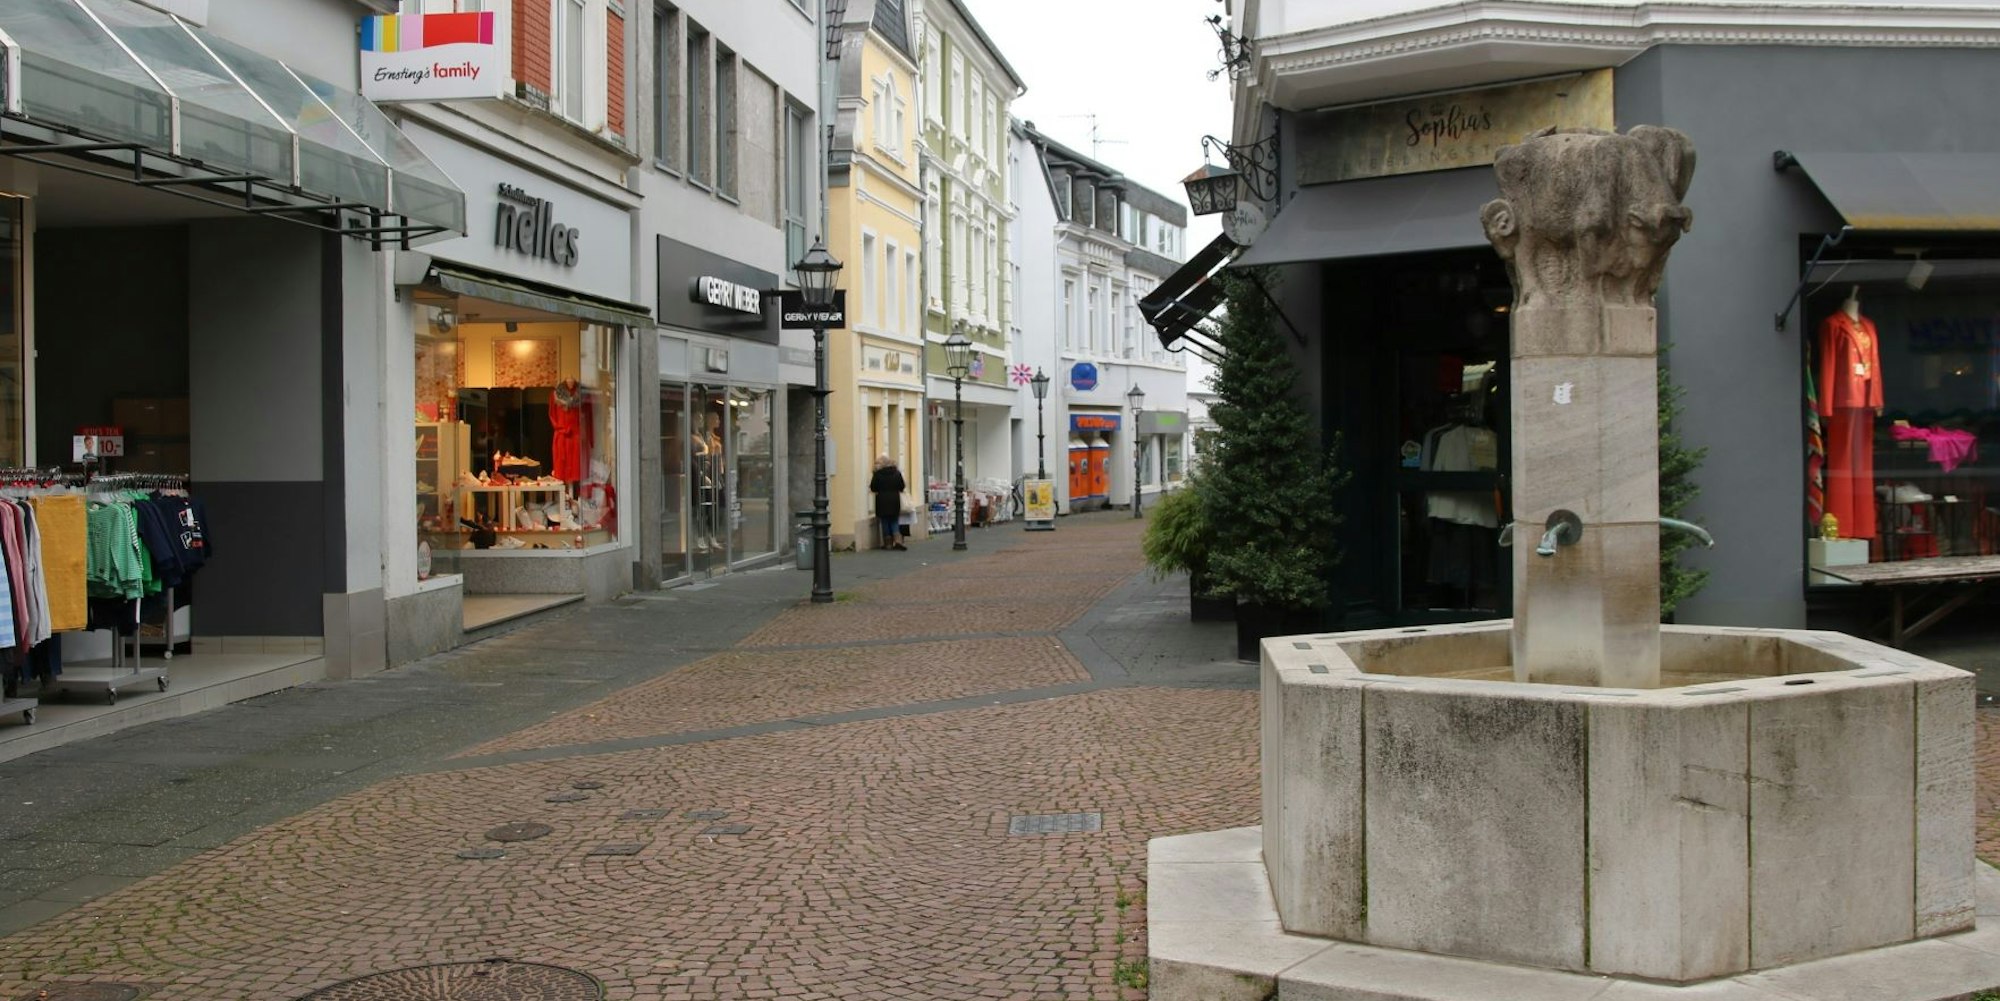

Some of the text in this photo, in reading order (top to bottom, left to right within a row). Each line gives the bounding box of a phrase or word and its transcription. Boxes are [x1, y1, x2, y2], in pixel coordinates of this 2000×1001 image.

[374, 62, 480, 84] Ernsting's family
[1406, 104, 1491, 147] Sophia's
[495, 198, 579, 267] nelles
[702, 275, 761, 315] GERRY WEBER
[100, 440, 122, 455] 10,-
